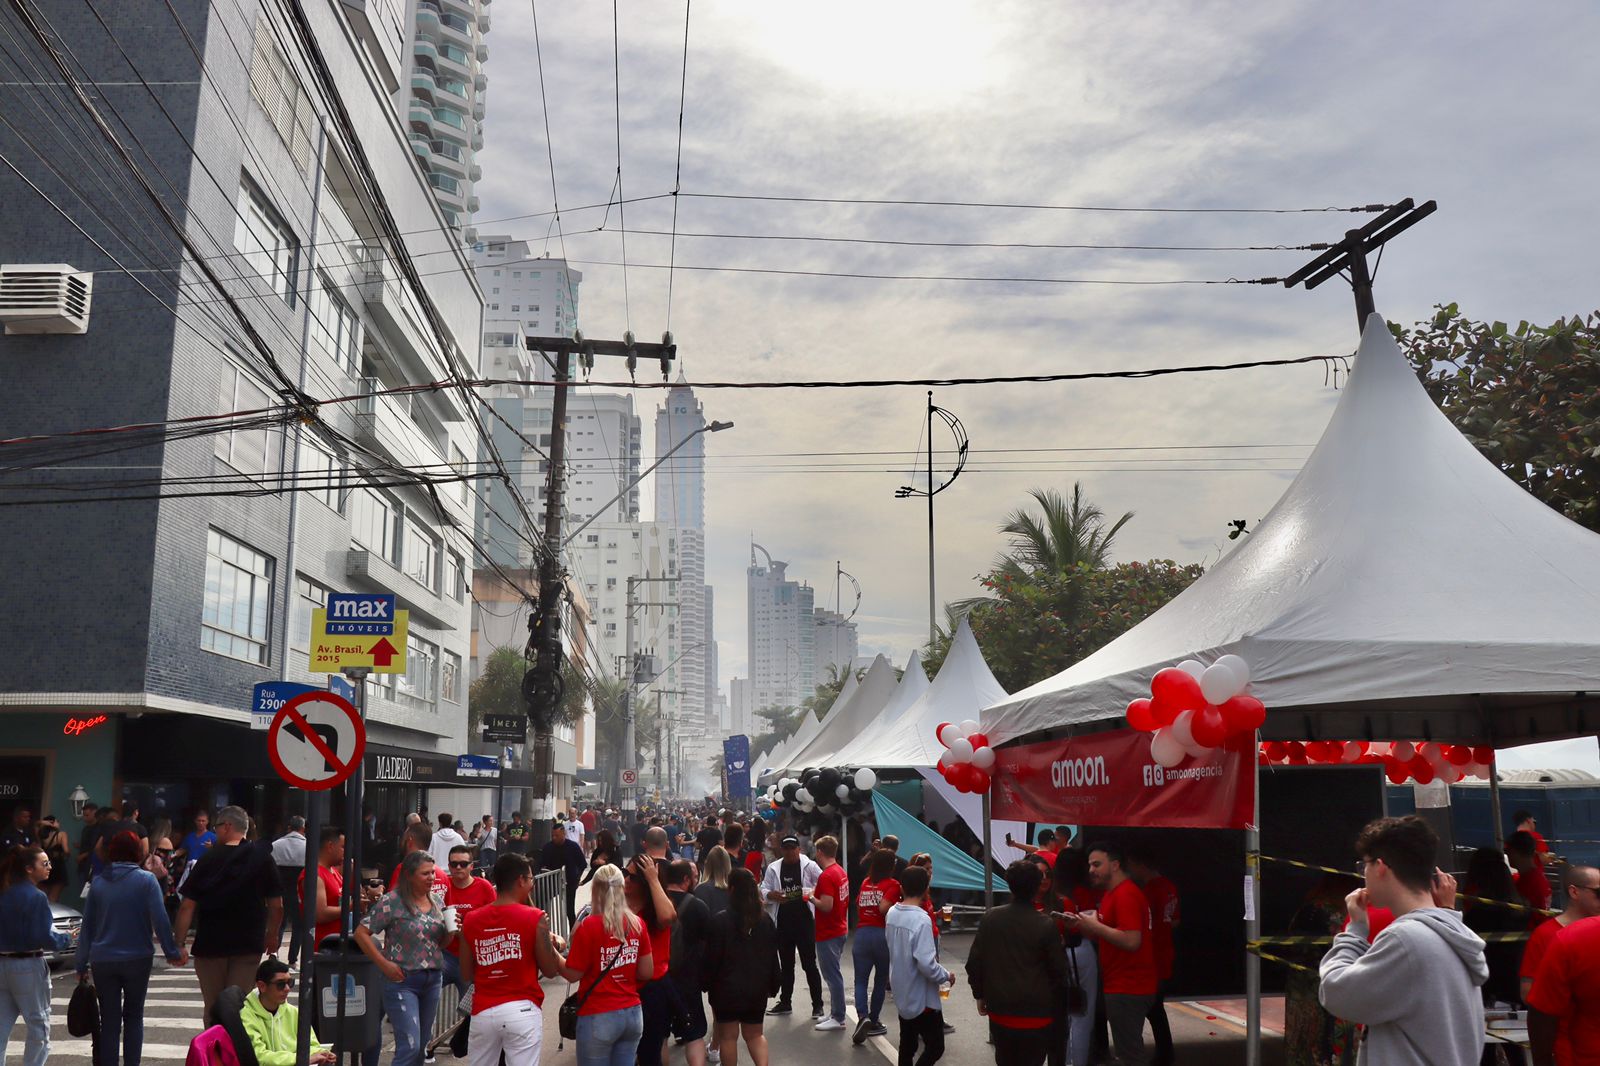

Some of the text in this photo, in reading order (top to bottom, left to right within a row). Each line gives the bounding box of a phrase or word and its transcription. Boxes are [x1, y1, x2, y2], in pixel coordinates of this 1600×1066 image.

[333, 600, 388, 617] max
[331, 624, 388, 632] IMÓVEIS
[317, 645, 364, 654] Av. Brasil,
[316, 655, 340, 663] 2015
[261, 689, 276, 698] Rua
[64, 715, 106, 735] Open
[376, 756, 413, 780] MADERO
[1051, 755, 1110, 788] amoon.
[1166, 761, 1223, 780] amoonagencia
[507, 933, 521, 941] VEZ
